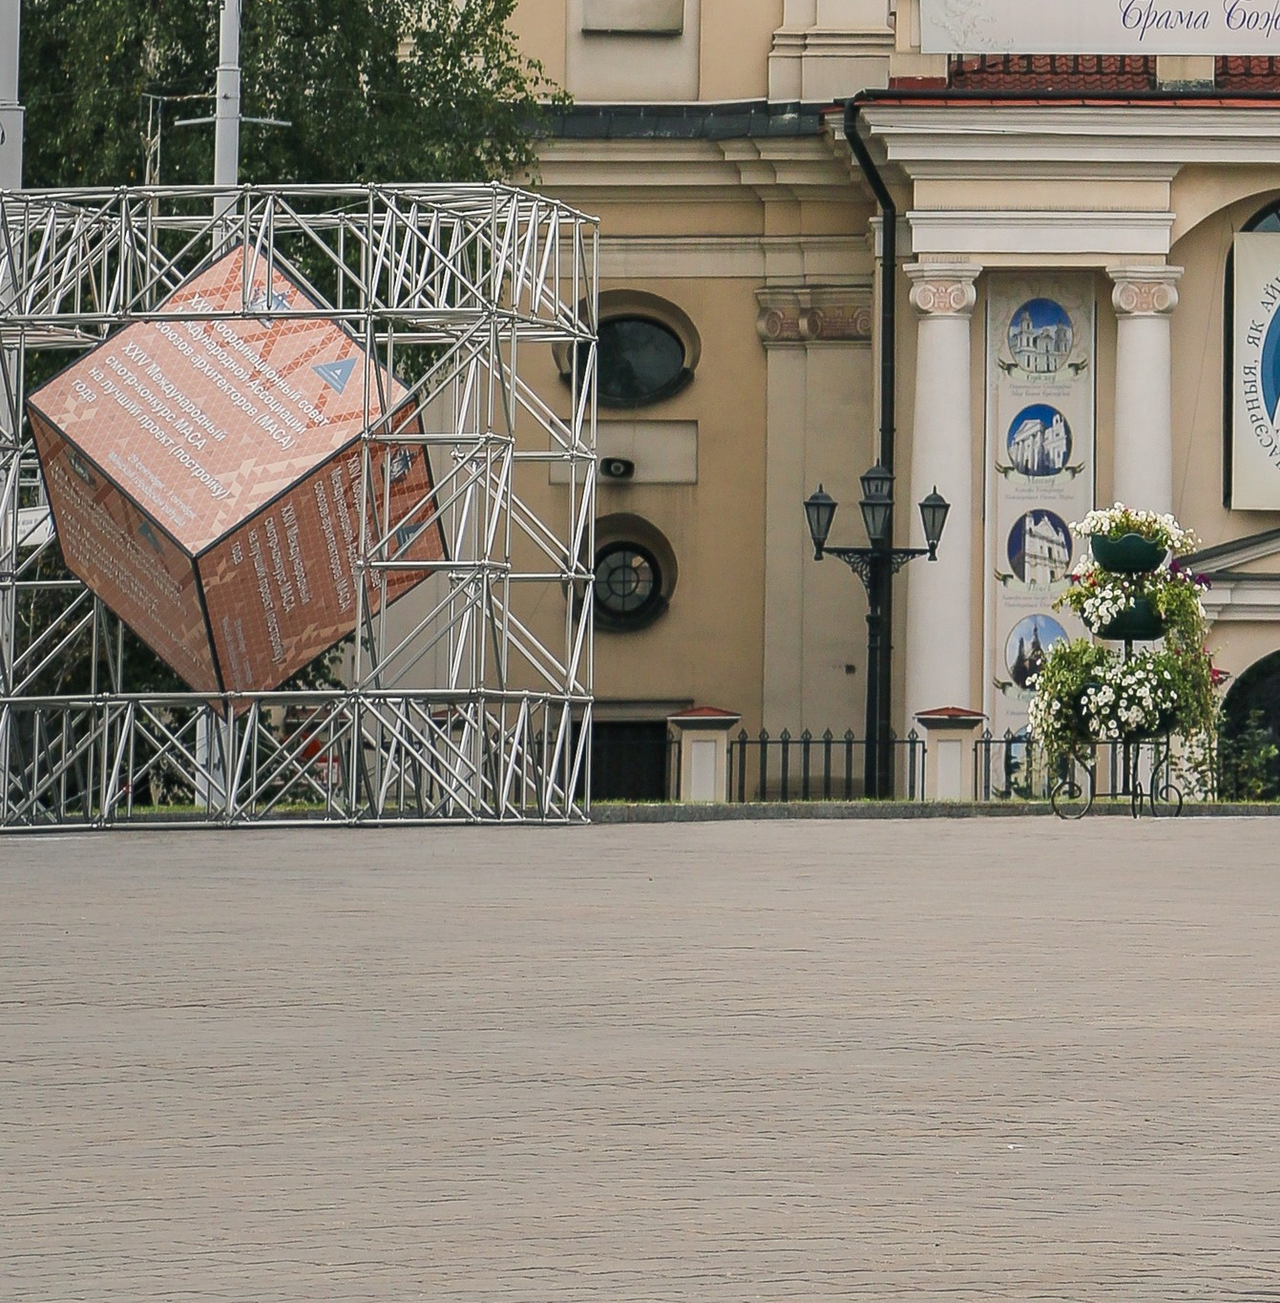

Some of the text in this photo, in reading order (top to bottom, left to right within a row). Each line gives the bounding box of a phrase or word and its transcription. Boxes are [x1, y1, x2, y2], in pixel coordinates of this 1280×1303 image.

[1247, 319, 1265, 349] ЯК
[71, 378, 98, 403] года
[105, 355, 207, 451] смотр-конкурс МАСА
[121, 340, 226, 442] XXIV Международный
[154, 321, 296, 451] союзов архитекторов (МАСА)
[245, 378, 308, 435] Ассоциации
[297, 399, 330, 427] совет
[87, 366, 232, 501] на лучший проект (постройку)
